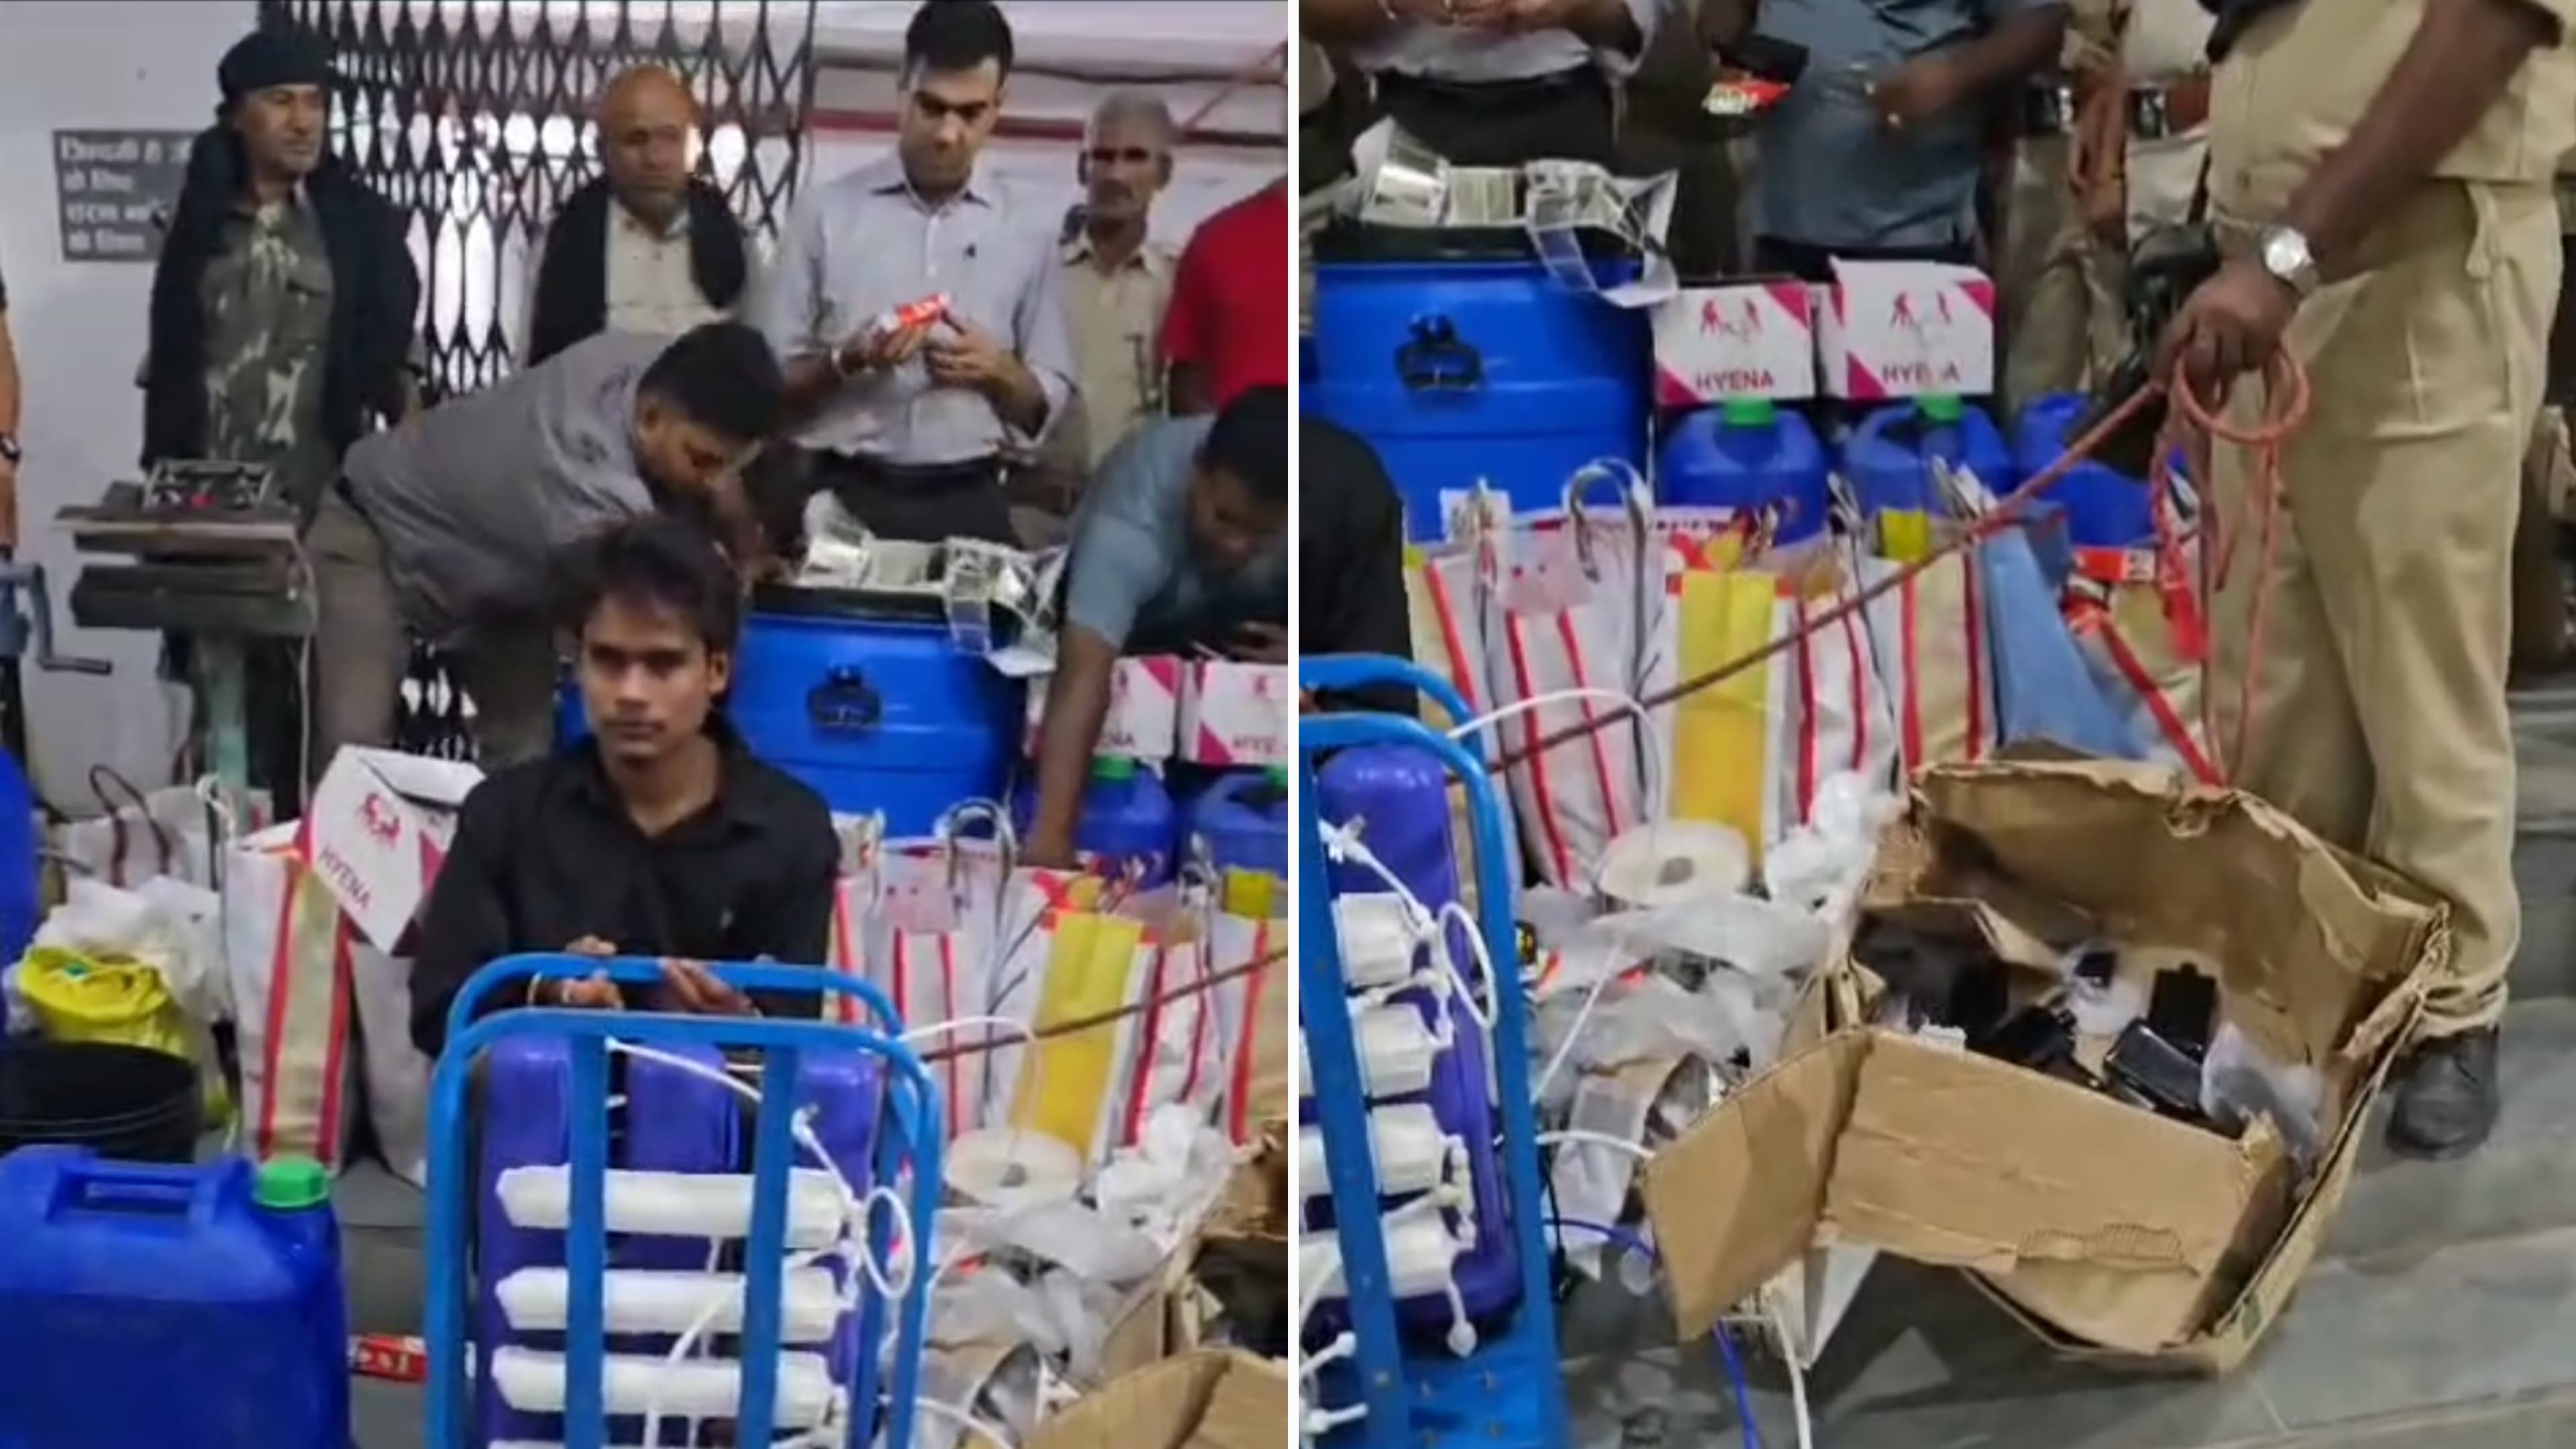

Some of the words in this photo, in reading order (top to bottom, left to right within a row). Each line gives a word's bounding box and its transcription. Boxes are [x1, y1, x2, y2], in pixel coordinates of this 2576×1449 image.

[1695, 368, 1774, 390] HYENA
[1882, 360, 1960, 384] HYEA
[319, 846, 370, 910] HYENA
